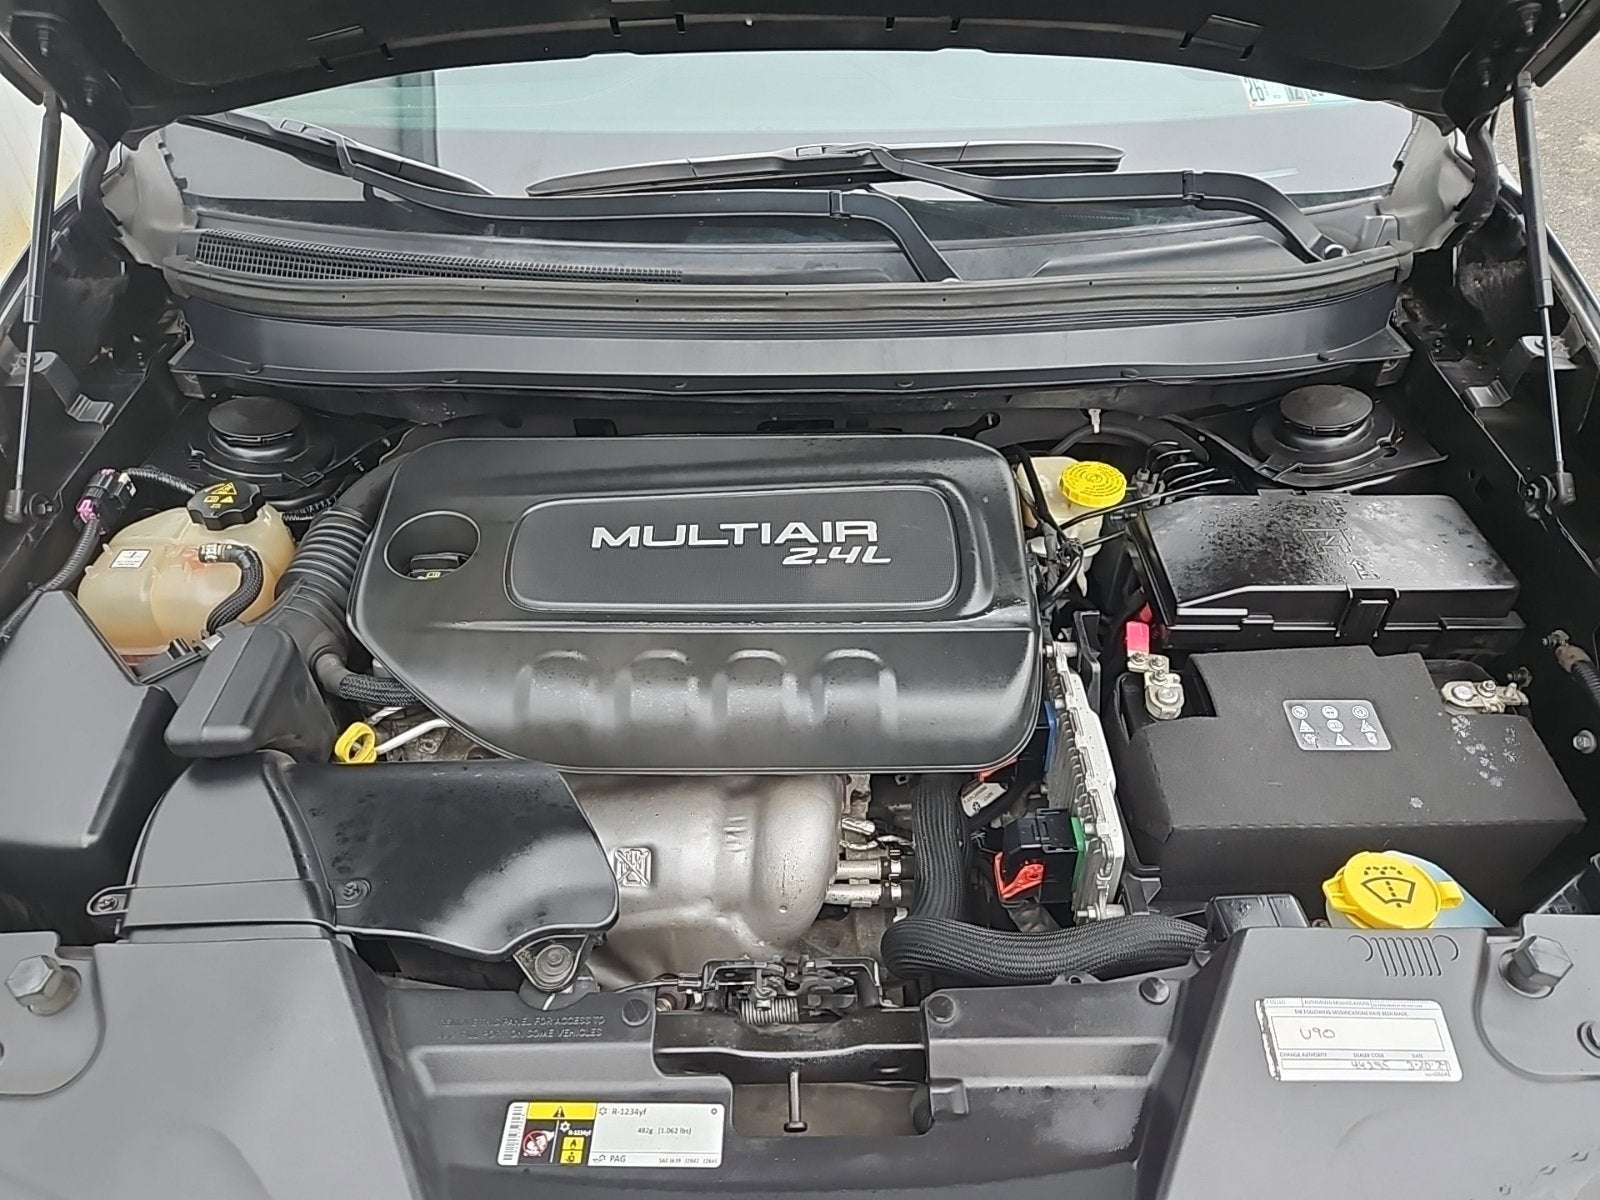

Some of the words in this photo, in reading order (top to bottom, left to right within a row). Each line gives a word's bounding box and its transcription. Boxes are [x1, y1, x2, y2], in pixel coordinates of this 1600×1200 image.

[591, 520, 879, 548] MULTIAIR
[782, 546, 892, 565] 2.4L
[533, 1017, 553, 1025] FOR
[554, 1016, 591, 1025] ACCESS
[592, 1015, 606, 1025] TO
[526, 1029, 554, 1038] SOME
[557, 1028, 603, 1037] VEHICLES
[1299, 1027, 1336, 1040] U90
[611, 1107, 647, 1117] R-1234yf
[637, 1127, 654, 1136] 482g
[657, 1127, 679, 1135] (1.062
[679, 1127, 692, 1135] lbs)
[609, 1154, 627, 1163] PAG
